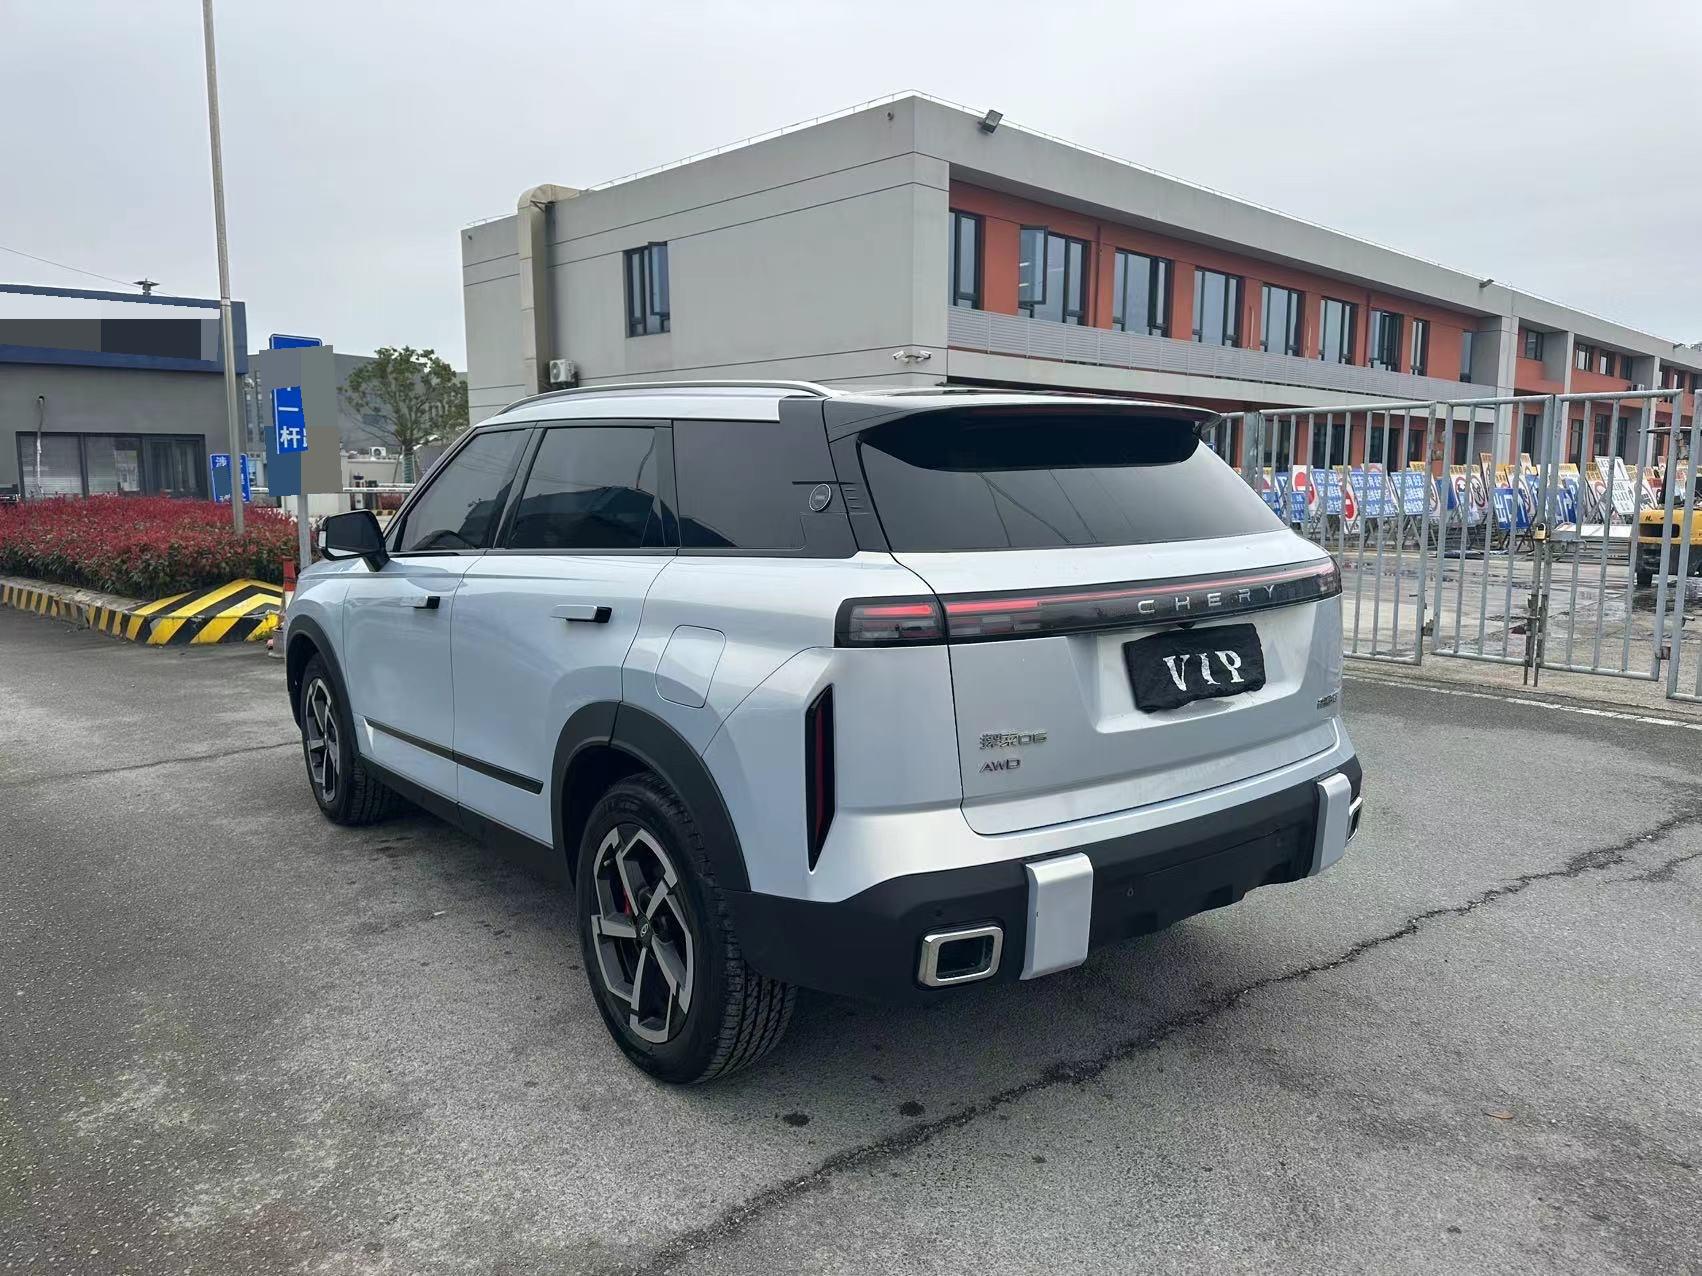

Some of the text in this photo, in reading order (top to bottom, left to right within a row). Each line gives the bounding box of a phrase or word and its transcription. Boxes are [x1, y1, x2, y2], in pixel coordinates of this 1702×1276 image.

[280, 425, 308, 449] 杆
[1137, 584, 1275, 615] CHERY
[1162, 650, 1245, 691] VIP
[979, 759, 1021, 773] AWD
